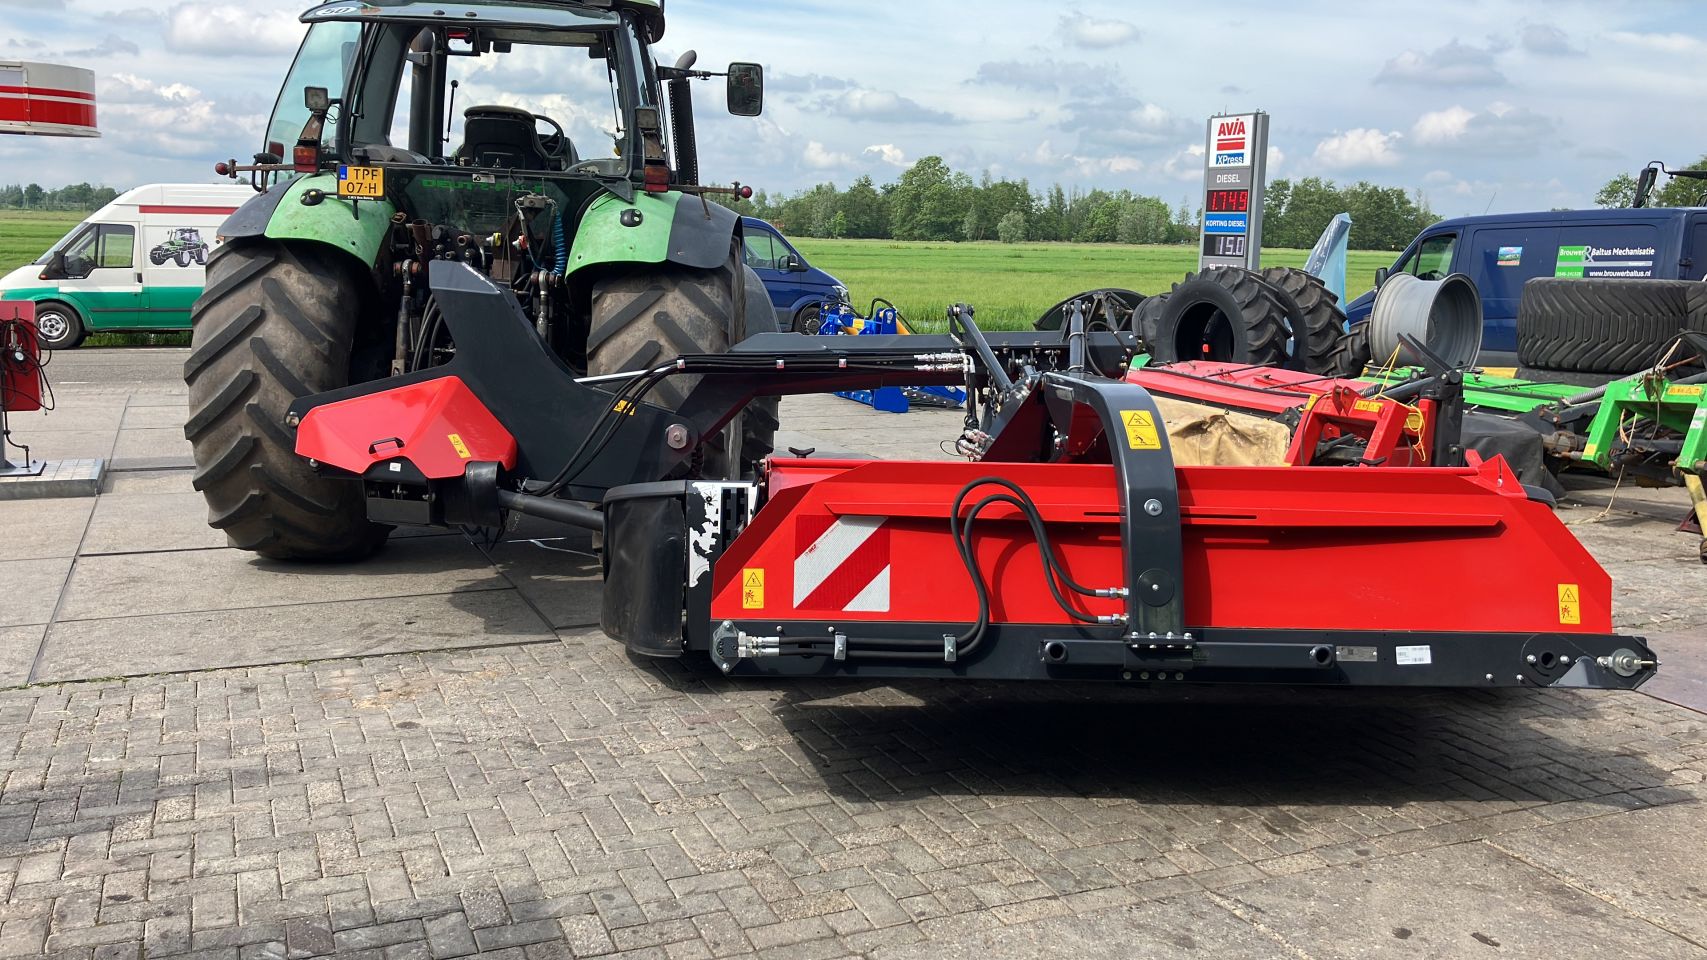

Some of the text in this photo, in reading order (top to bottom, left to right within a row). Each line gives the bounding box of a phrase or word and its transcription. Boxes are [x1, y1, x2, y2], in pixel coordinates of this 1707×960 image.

[1218, 118, 1245, 136] AVIA
[1217, 154, 1244, 165] XPress
[354, 169, 378, 180] TPF
[1216, 174, 1240, 183] DIESEL
[346, 182, 376, 194] 07-H
[1591, 247, 1612, 256] Baltus
[1612, 247, 1655, 256] Mechanisatie
